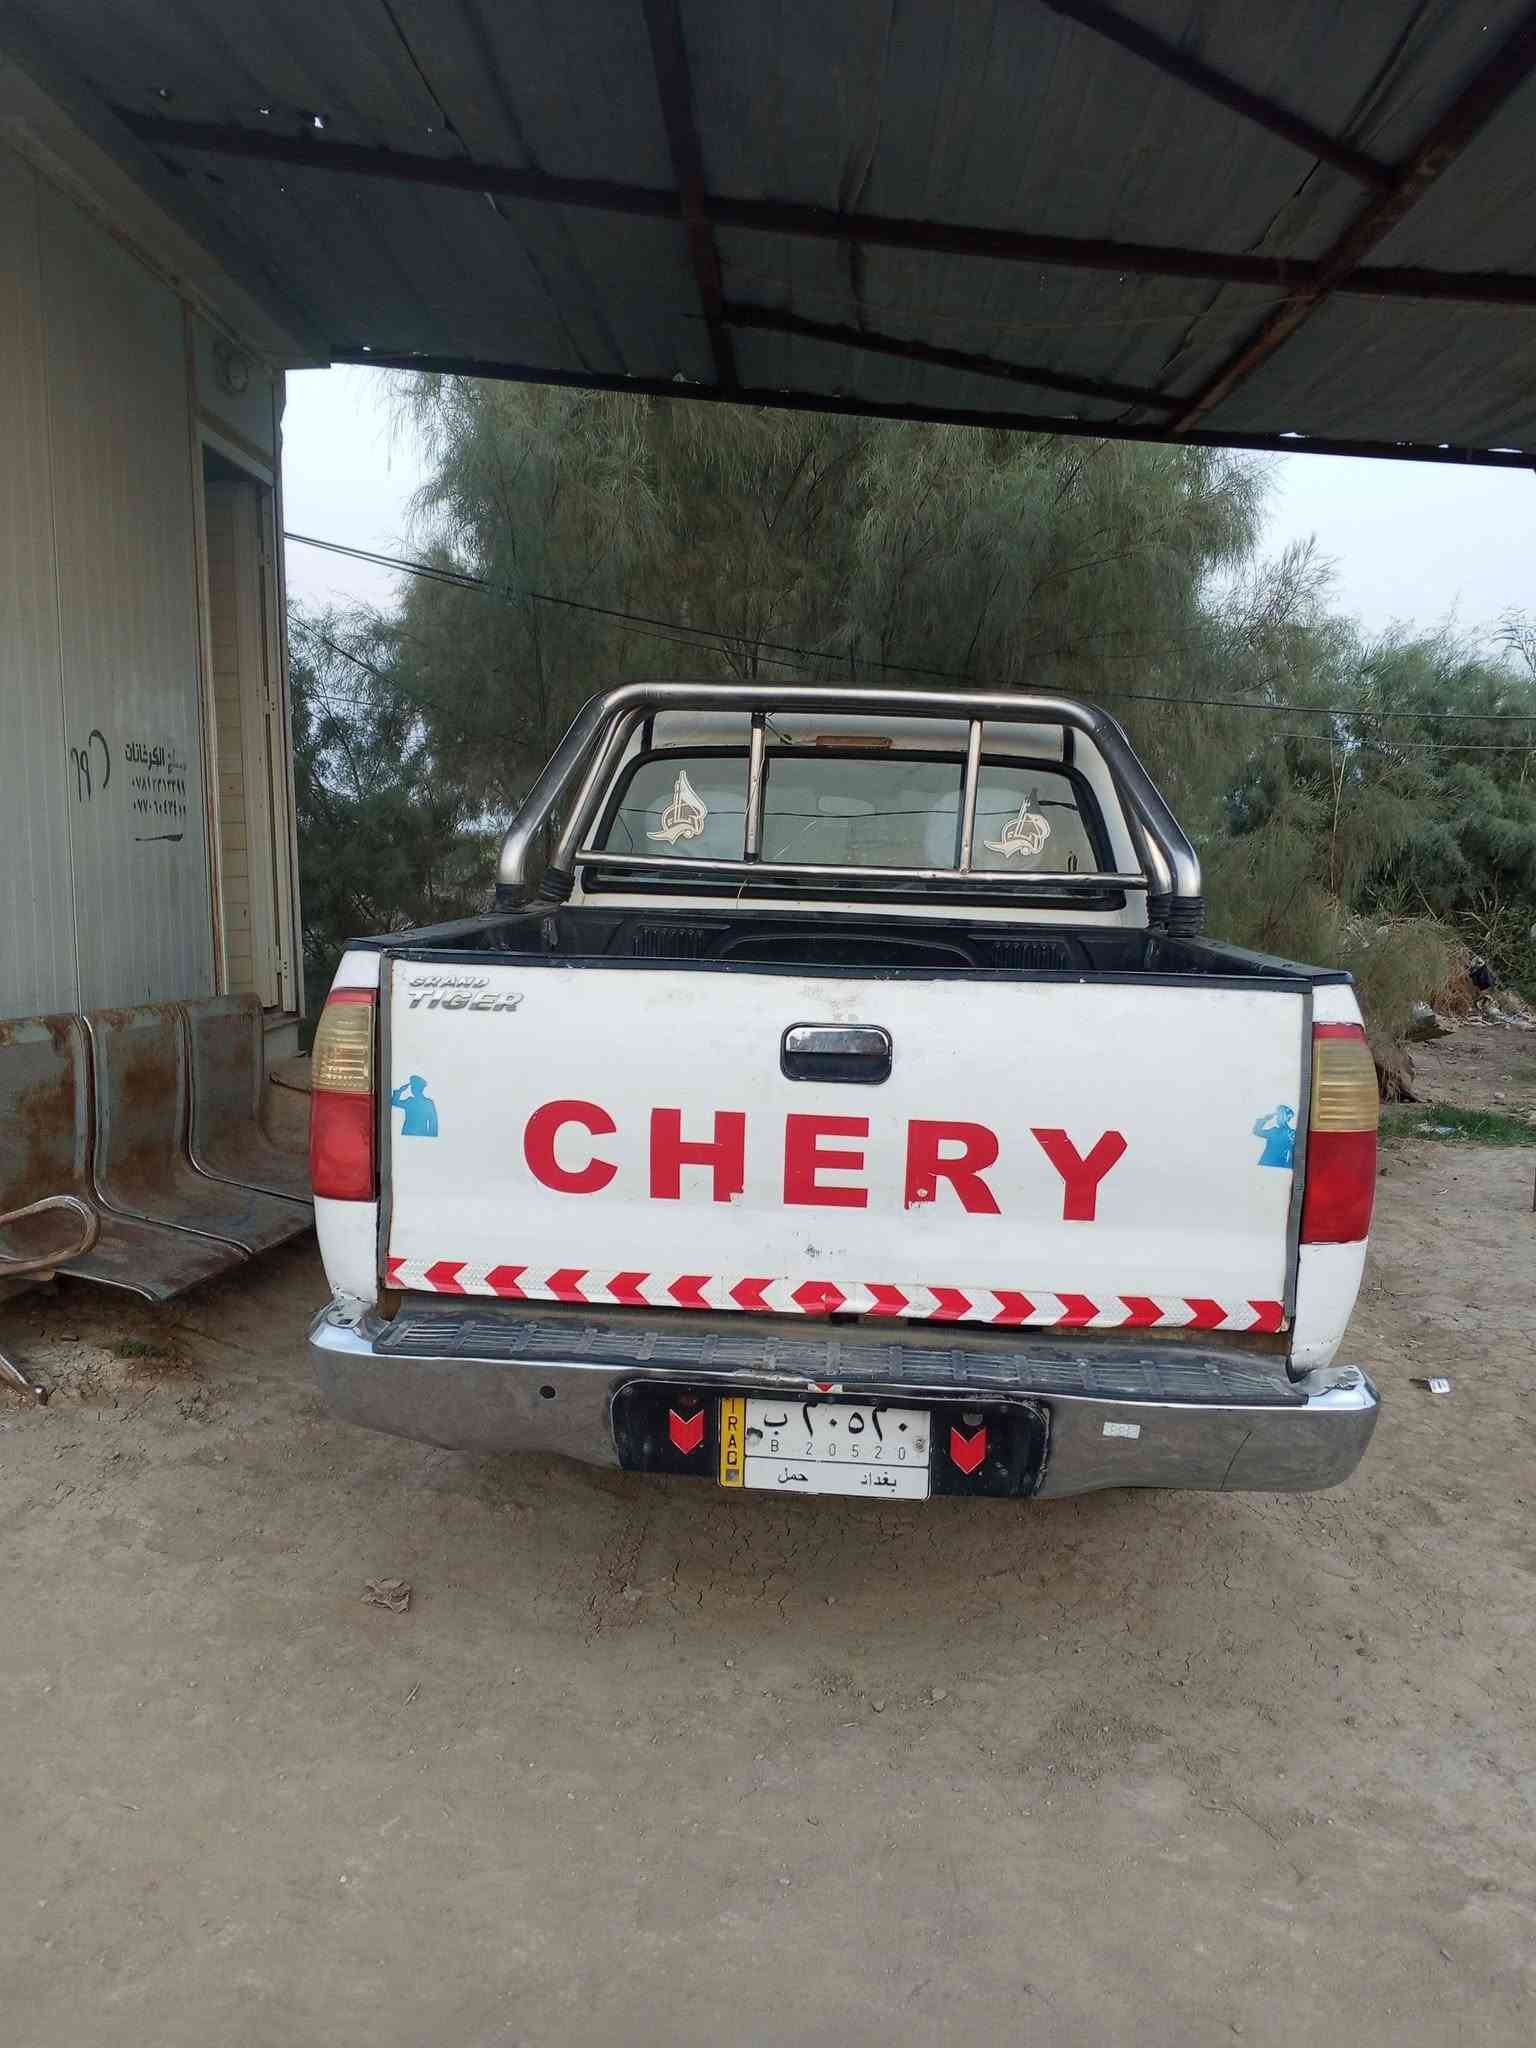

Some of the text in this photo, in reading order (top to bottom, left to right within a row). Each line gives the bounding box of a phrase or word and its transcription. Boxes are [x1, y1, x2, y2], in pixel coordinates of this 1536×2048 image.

[409, 975, 490, 989] GRAND
[408, 989, 524, 1012] TIGER
[523, 1099, 1128, 1221] CHERY
[726, 1399, 738, 1465] IRAQ
[770, 1439, 906, 1461] B 20520
[777, 1467, 897, 1493] بغداد حمل
